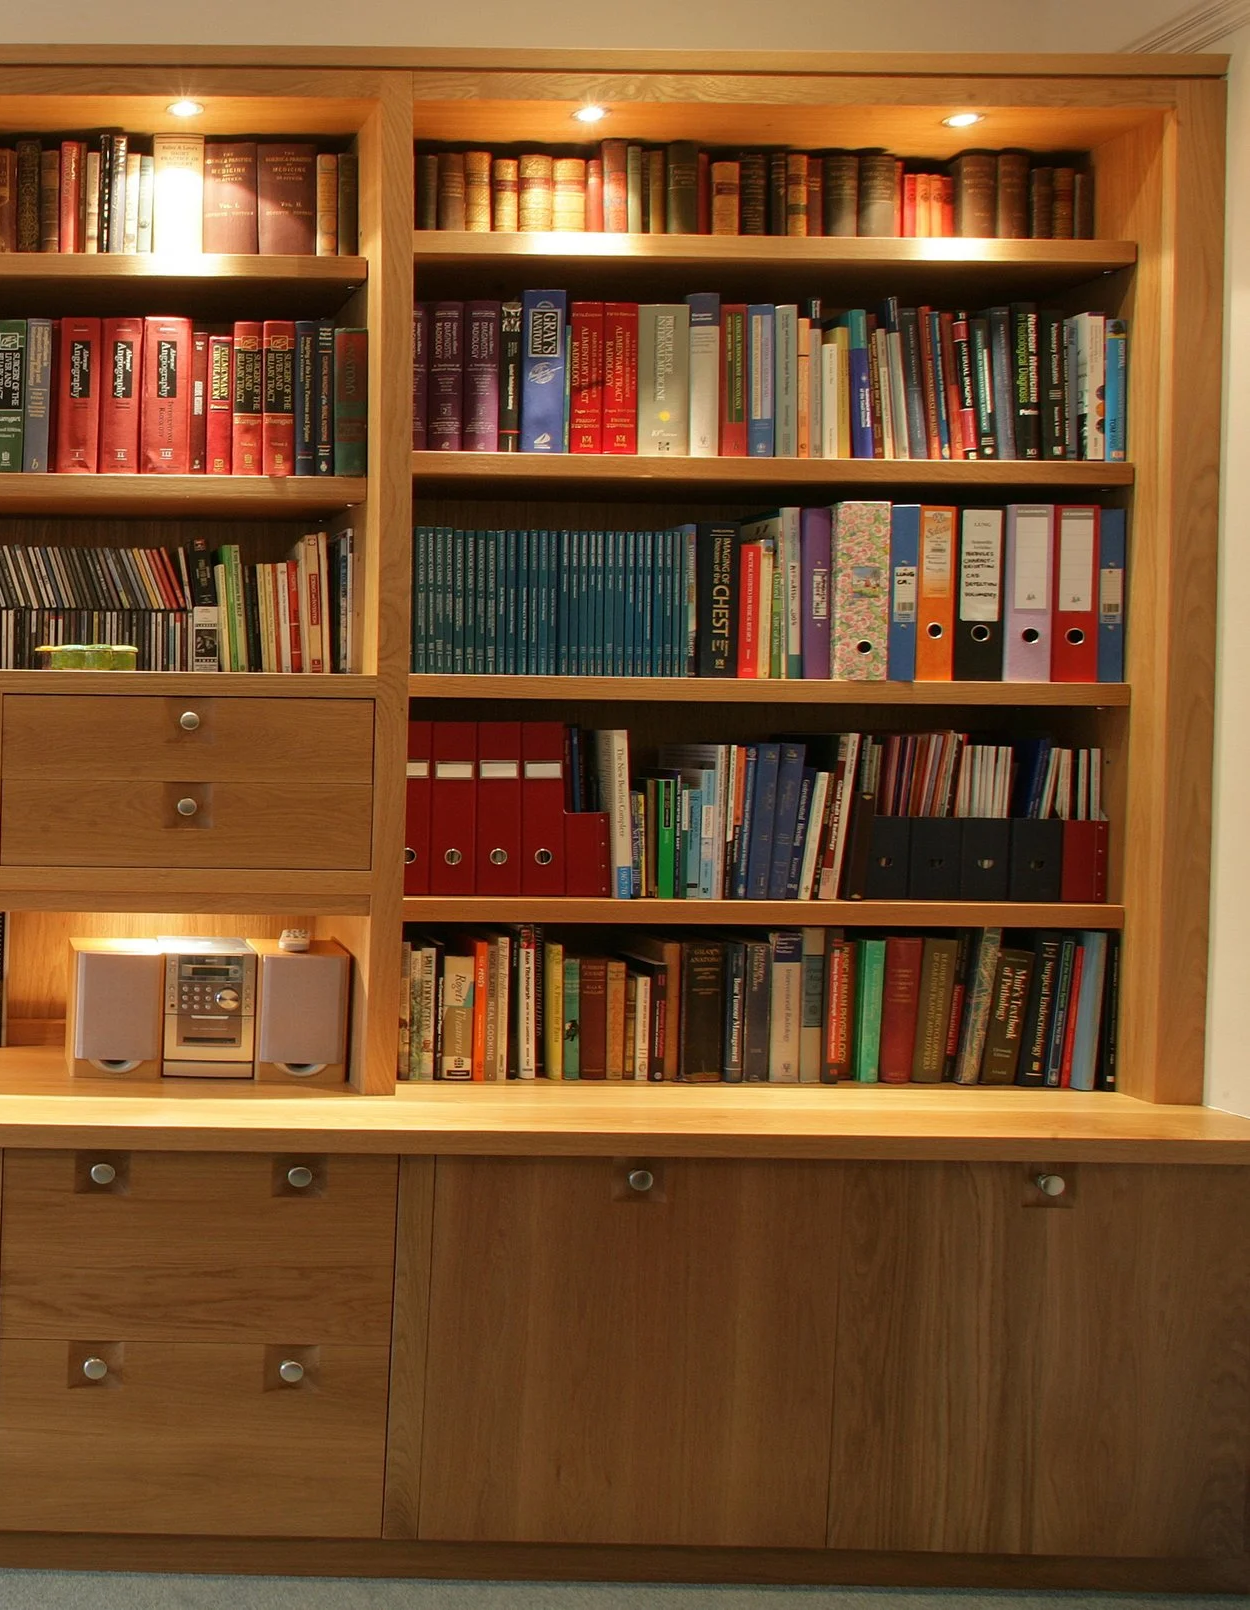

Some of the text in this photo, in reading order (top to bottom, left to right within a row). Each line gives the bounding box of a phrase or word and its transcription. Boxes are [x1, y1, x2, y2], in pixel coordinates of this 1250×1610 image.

[434, 322, 443, 353] RADIOLOGY
[471, 322, 479, 353] RADIOLOGY
[480, 322, 488, 353] DIAGNOSTIC
[532, 313, 542, 354] ANATOMY
[543, 313, 557, 353] GRAY'S
[581, 326, 589, 375] ALIMENTARY
[665, 316, 674, 363] PRINCIPLES
[1016, 322, 1028, 366] Radiological
[1050, 323, 1058, 353] Pulmonary
[4, 352, 12, 388] LIVER AND
[11, 352, 21, 406] SURGERY OF THE
[71, 343, 82, 398] Angiography
[114, 342, 126, 398] Angiography
[159, 341, 171, 398] Angiography
[212, 345, 221, 399] CIRCULATION
[221, 347, 229, 398] PULMONARY
[245, 353, 253, 391] LIVER AND
[252, 353, 261, 410] SURGERY OF THE
[605, 341, 613, 387] RADIOLOGY
[615, 325, 623, 403] ALIMENTARY TRACT
[657, 316, 666, 401] INTERNAL MEDICINE
[961, 343, 972, 406] ARTERIAL IMAGING
[1028, 314, 1039, 403] Nuclear Medicine
[236, 380, 245, 403] TRACT
[267, 380, 275, 403] TRACT
[284, 385, 291, 394] OF
[1019, 367, 1029, 403] Diagnosis
[1109, 418, 1117, 433] TOM
[713, 537, 722, 584] Diseases of the
[723, 537, 731, 584] IMAGING OF
[711, 585, 729, 637] CHEST
[618, 780, 626, 803] Beatles
[617, 804, 626, 837] Complete
[422, 956, 433, 1032] PAUL EDDINGTON
[840, 974, 848, 1006] HUMAN
[928, 994, 936, 1019] PLANTS
[948, 985, 963, 1037] Musculoskeletal
[995, 967, 1012, 1021] of Pathology
[1005, 969, 1027, 1039] Muir's Textbook
[1031, 961, 1056, 1058] Surgical Endocrinology
[452, 974, 467, 1055] Roget's Thesaurus
[730, 978, 741, 1062] Bone Tumour Management
[487, 1023, 495, 1061] COOKING
